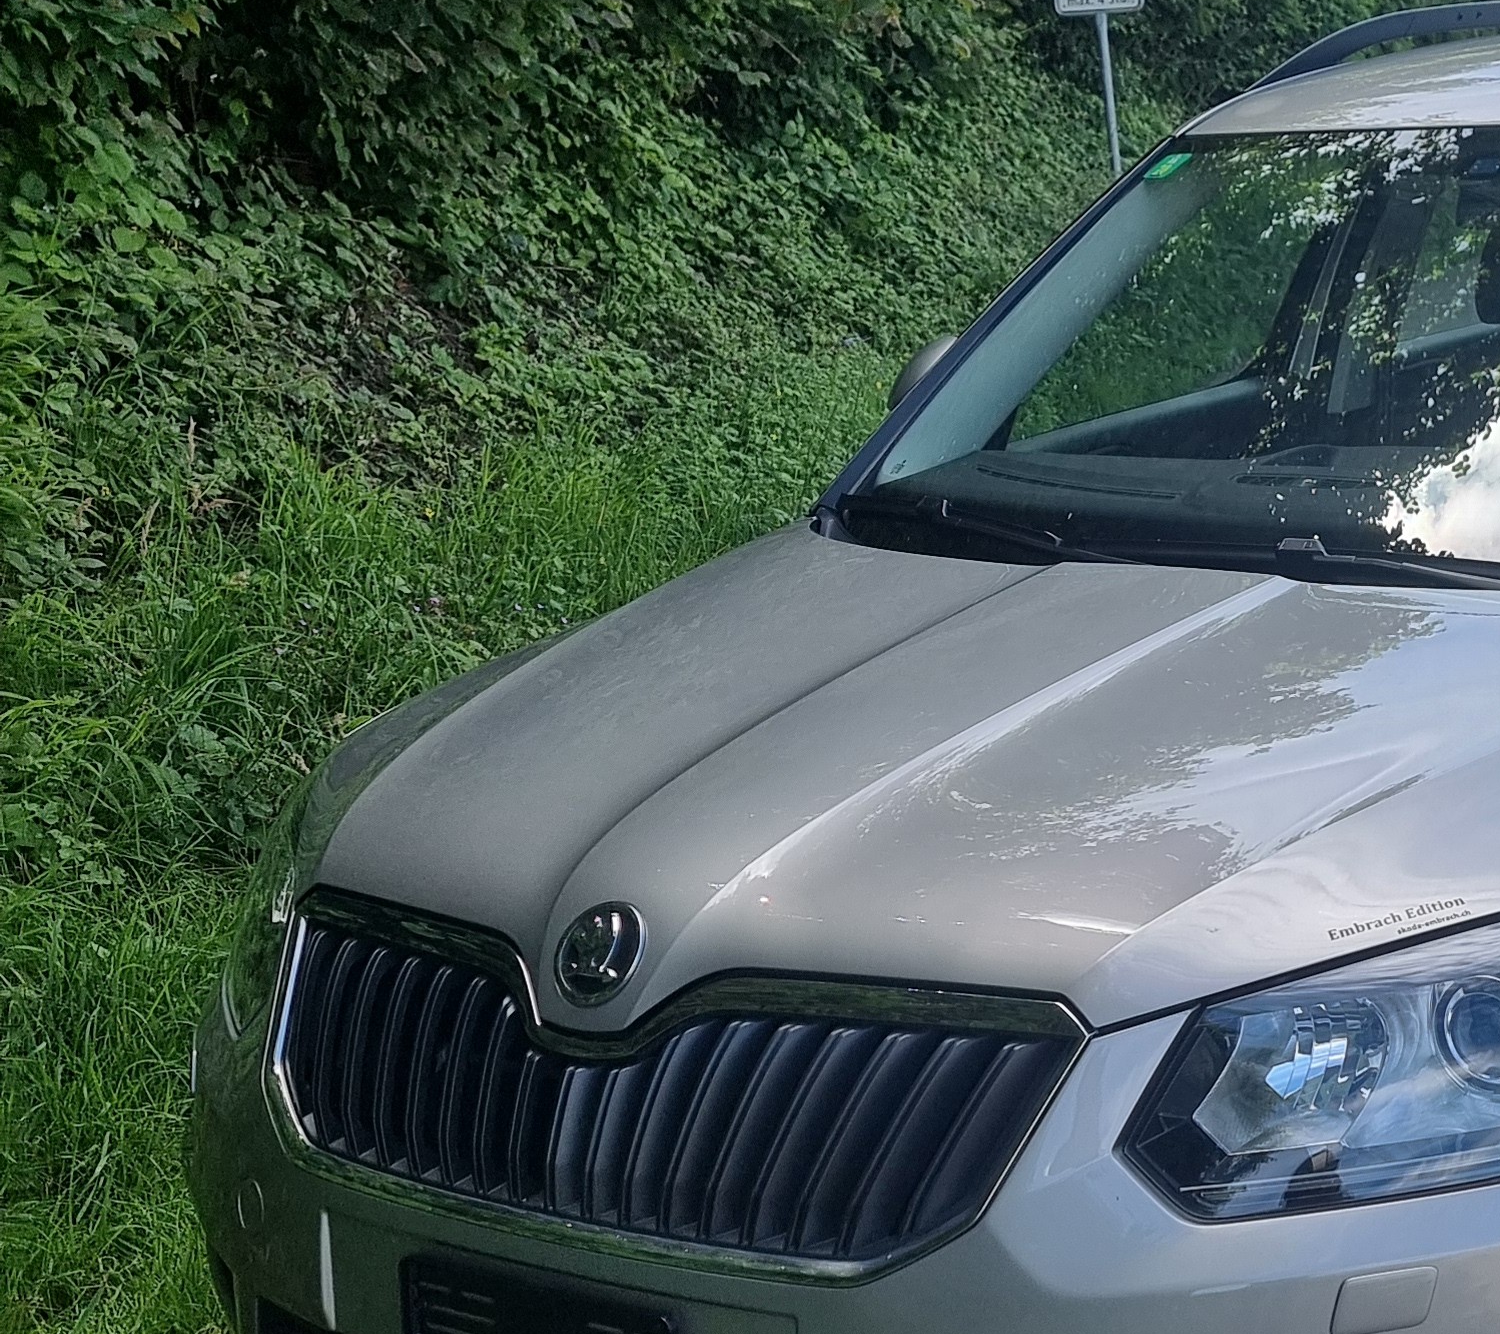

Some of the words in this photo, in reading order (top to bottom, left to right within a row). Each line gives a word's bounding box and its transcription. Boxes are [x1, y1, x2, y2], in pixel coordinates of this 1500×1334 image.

[1327, 912, 1403, 941] Embrach
[1405, 897, 1466, 920] Edition
[1397, 910, 1472, 935] skoda-embrach.ch
